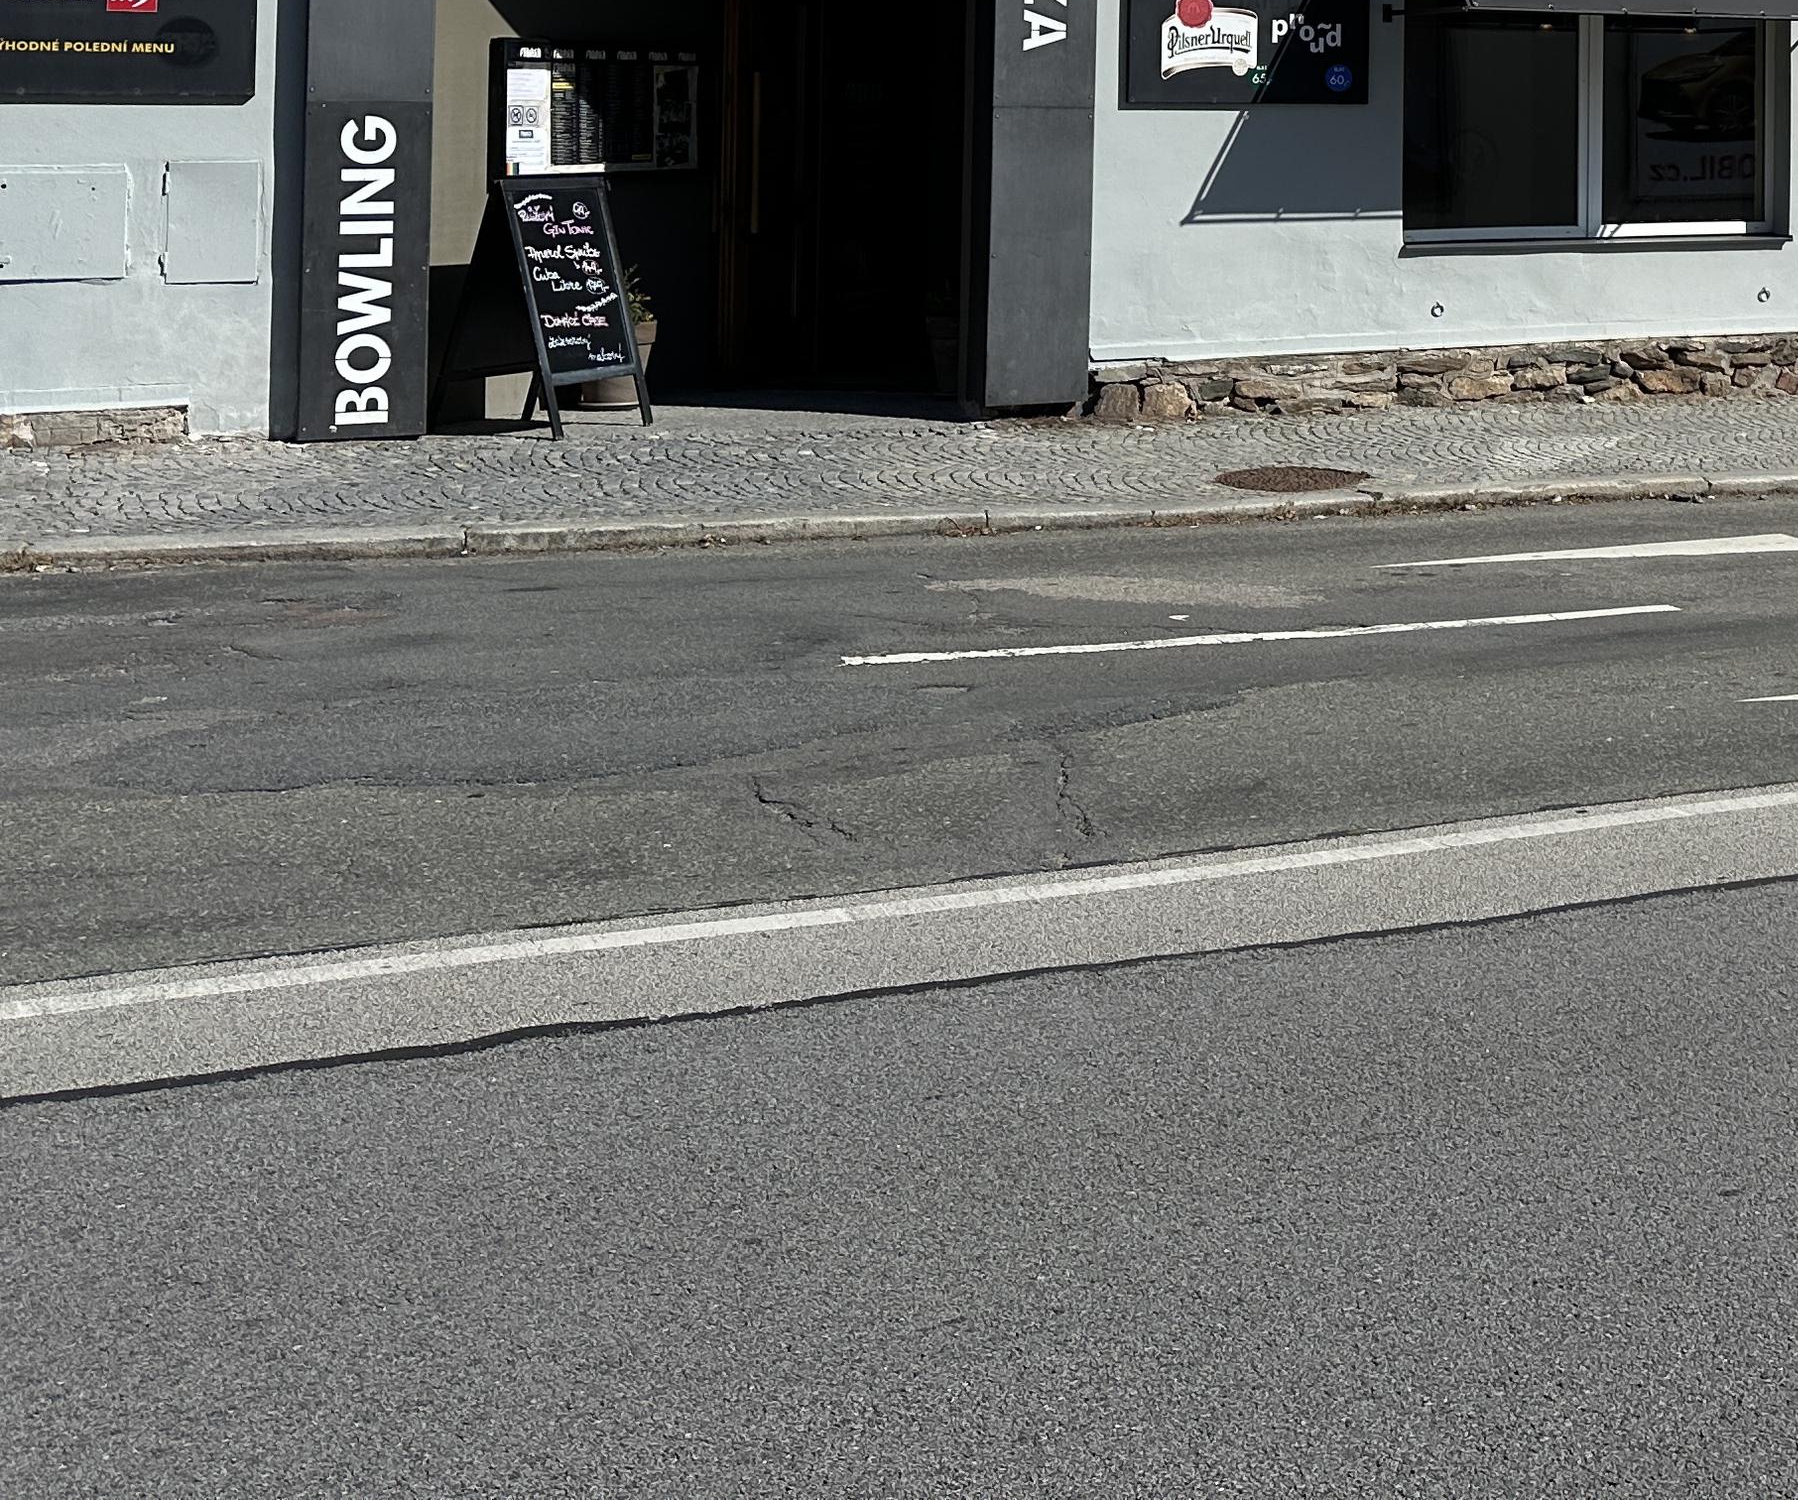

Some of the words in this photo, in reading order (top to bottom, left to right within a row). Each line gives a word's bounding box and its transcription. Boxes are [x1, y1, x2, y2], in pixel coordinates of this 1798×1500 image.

[0, 37, 59, 51] ÝHODNÉ
[64, 40, 128, 53] POLEDNÍ
[131, 42, 175, 54] MENU
[1167, 25, 1211, 59] Pilsner
[1210, 25, 1252, 54] Urquell
[334, 115, 397, 426] BOWLING
